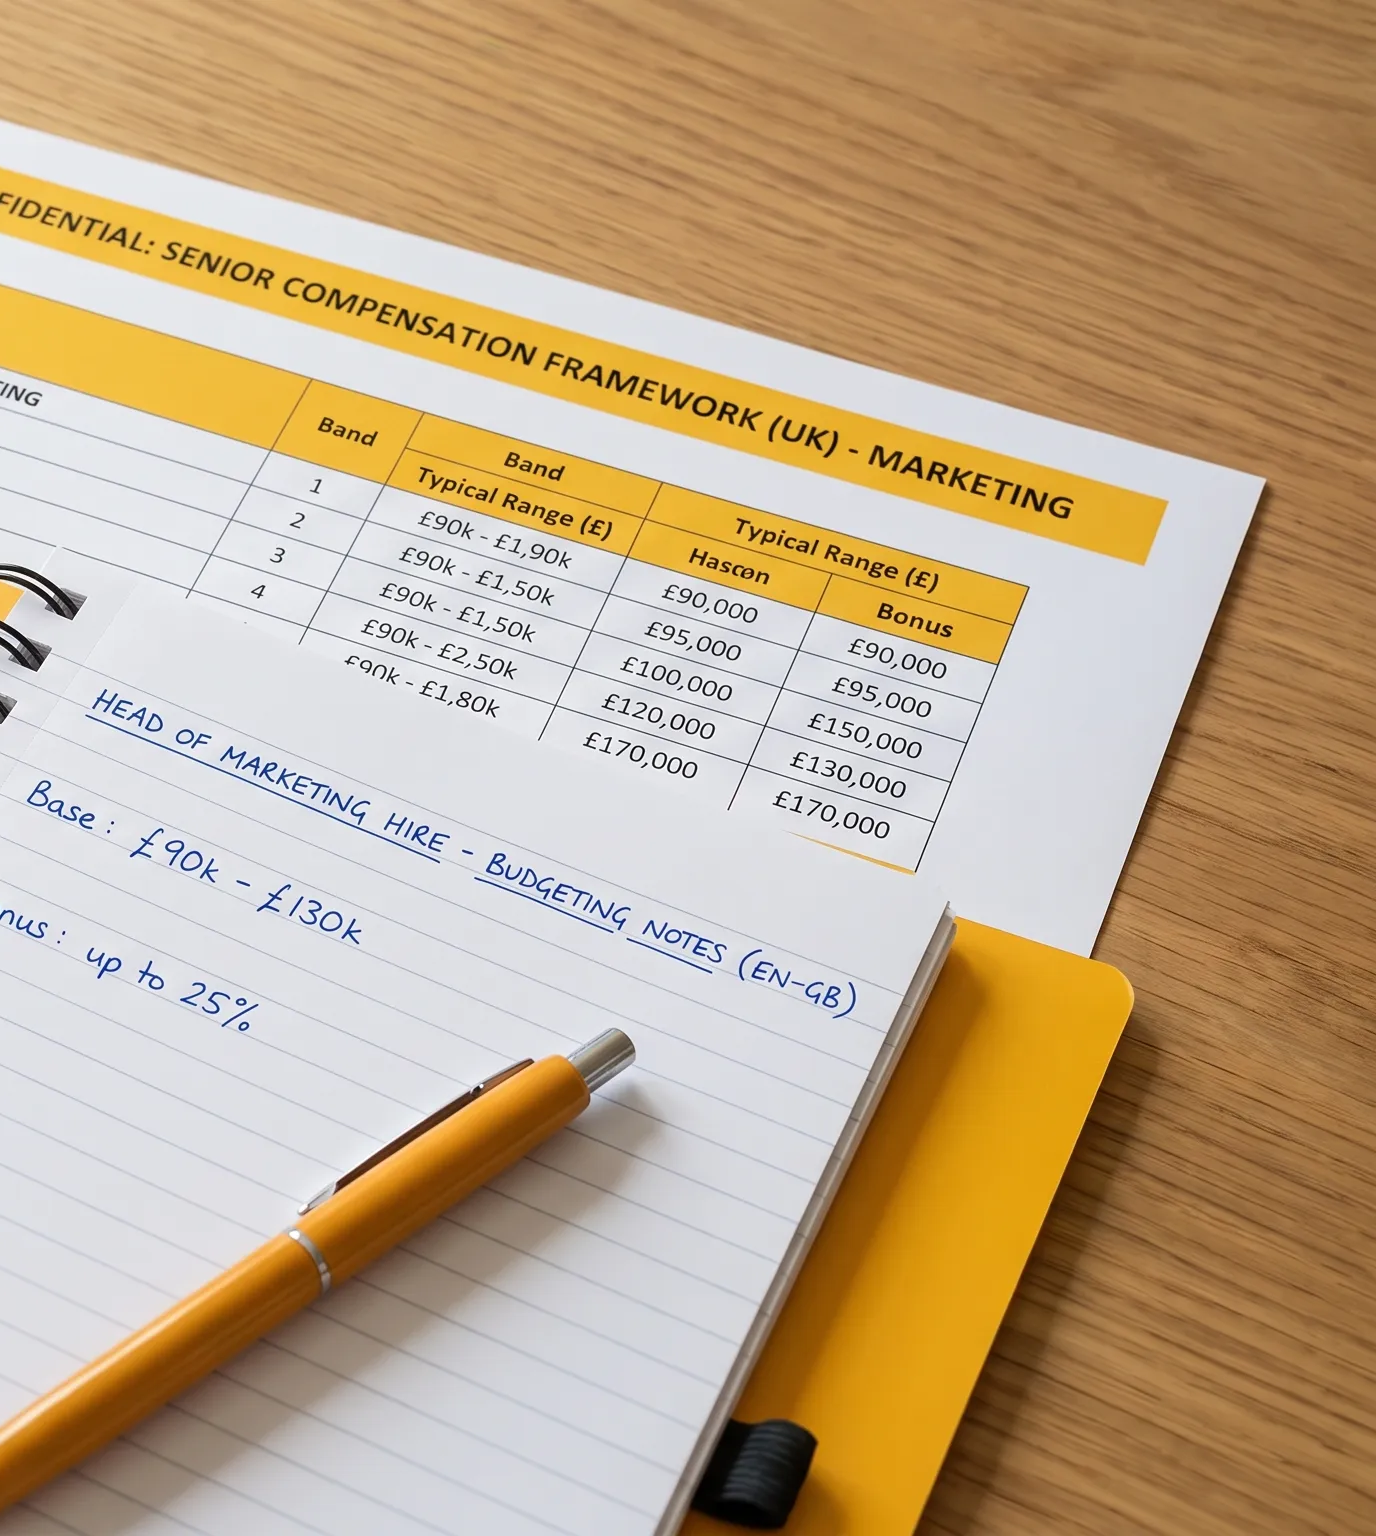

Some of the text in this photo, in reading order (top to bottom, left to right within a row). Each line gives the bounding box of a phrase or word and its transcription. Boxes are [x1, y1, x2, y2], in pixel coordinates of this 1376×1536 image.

[160, 241, 276, 290] SENIOR
[282, 276, 538, 367] COMPENSATION
[542, 351, 764, 432] FRAMEWORK
[767, 414, 839, 459] (UK)
[867, 444, 1075, 520] MARKETING
[317, 416, 379, 448] Band
[309, 478, 323, 495] 1
[503, 451, 566, 482] Band
[289, 512, 306, 530] 2
[418, 466, 613, 542] Typical Range (£)
[269, 547, 286, 564] 3
[417, 511, 475, 541] £90k
[492, 533, 573, 570] £1,90k
[735, 517, 940, 595] Typical Range (£)
[250, 584, 267, 600] 4
[398, 546, 457, 577] £90k
[474, 569, 555, 607] £1,50k
[378, 582, 438, 613] £90k
[455, 606, 537, 643] £1,50k
[661, 584, 759, 624] £90,000
[876, 602, 954, 638] Bonus
[360, 619, 420, 650] £90k
[436, 643, 518, 681] £2,50k
[643, 621, 742, 662] £95,000
[847, 638, 948, 680] £90,000
[418, 680, 501, 719] £1,80k
[619, 656, 733, 702] £100,000
[831, 676, 932, 718] £95,000
[600, 693, 716, 740] £120,000
[806, 712, 923, 759] £150,000
[582, 731, 699, 779] £170,000
[789, 751, 907, 799] £130,000
[771, 790, 891, 839] £170,000
[92, 689, 163, 732] HEAD
[176, 729, 212, 749] OF
[220, 746, 371, 825] MARKETING
[384, 813, 450, 852] HIRE
[486, 853, 631, 931] BUDGETING
[642, 920, 727, 963] NOTES
[739, 949, 856, 1019] (EN-GB)
[130, 828, 219, 883] £90k
[256, 884, 362, 944] £130k
[87, 948, 122, 979] up
[138, 960, 164, 990] to
[180, 982, 259, 1031] 25%
